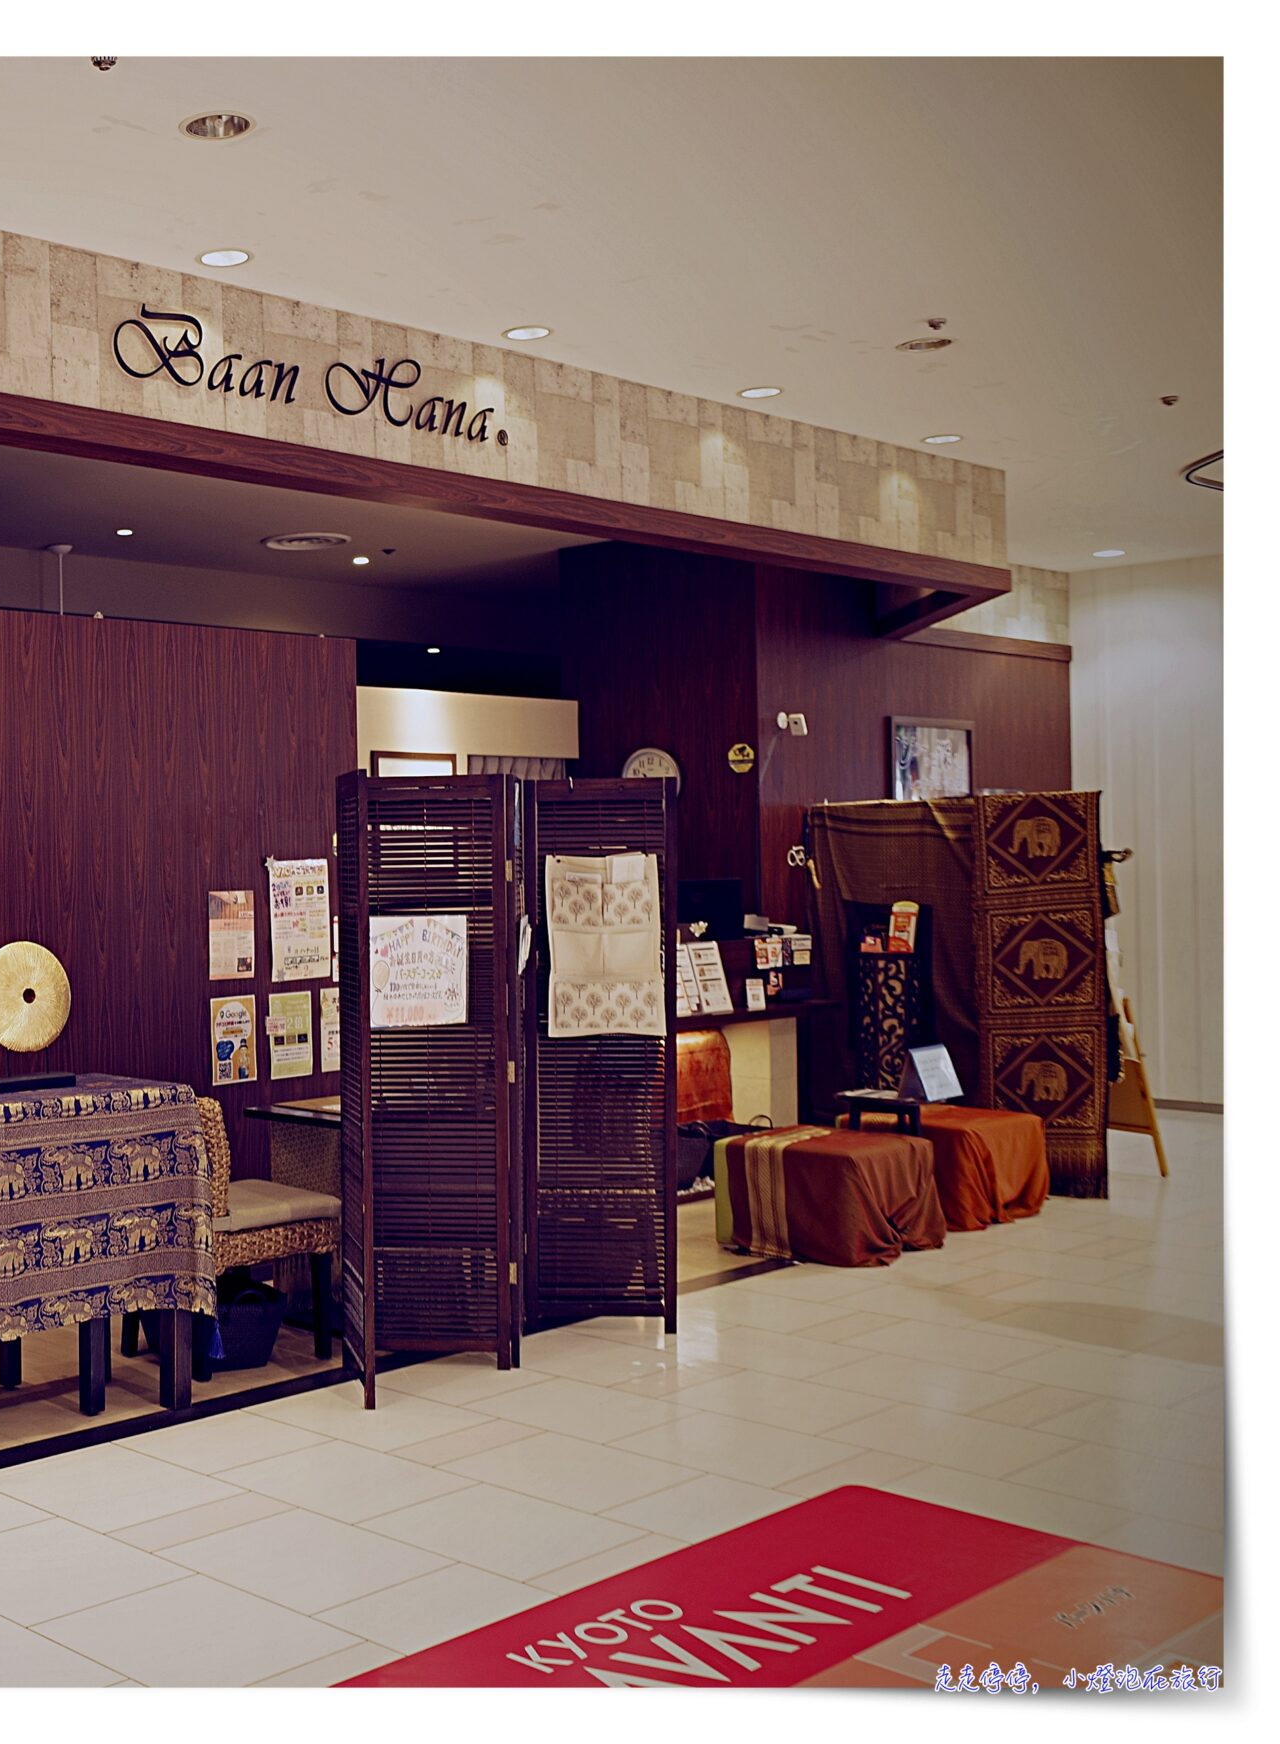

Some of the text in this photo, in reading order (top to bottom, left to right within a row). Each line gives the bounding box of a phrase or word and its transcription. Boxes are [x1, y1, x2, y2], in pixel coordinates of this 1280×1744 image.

[113, 303, 300, 404] Baan
[325, 358, 495, 445] Hana
[225, 1008, 247, 1020] Google
[506, 1599, 683, 1674] KYOTO
